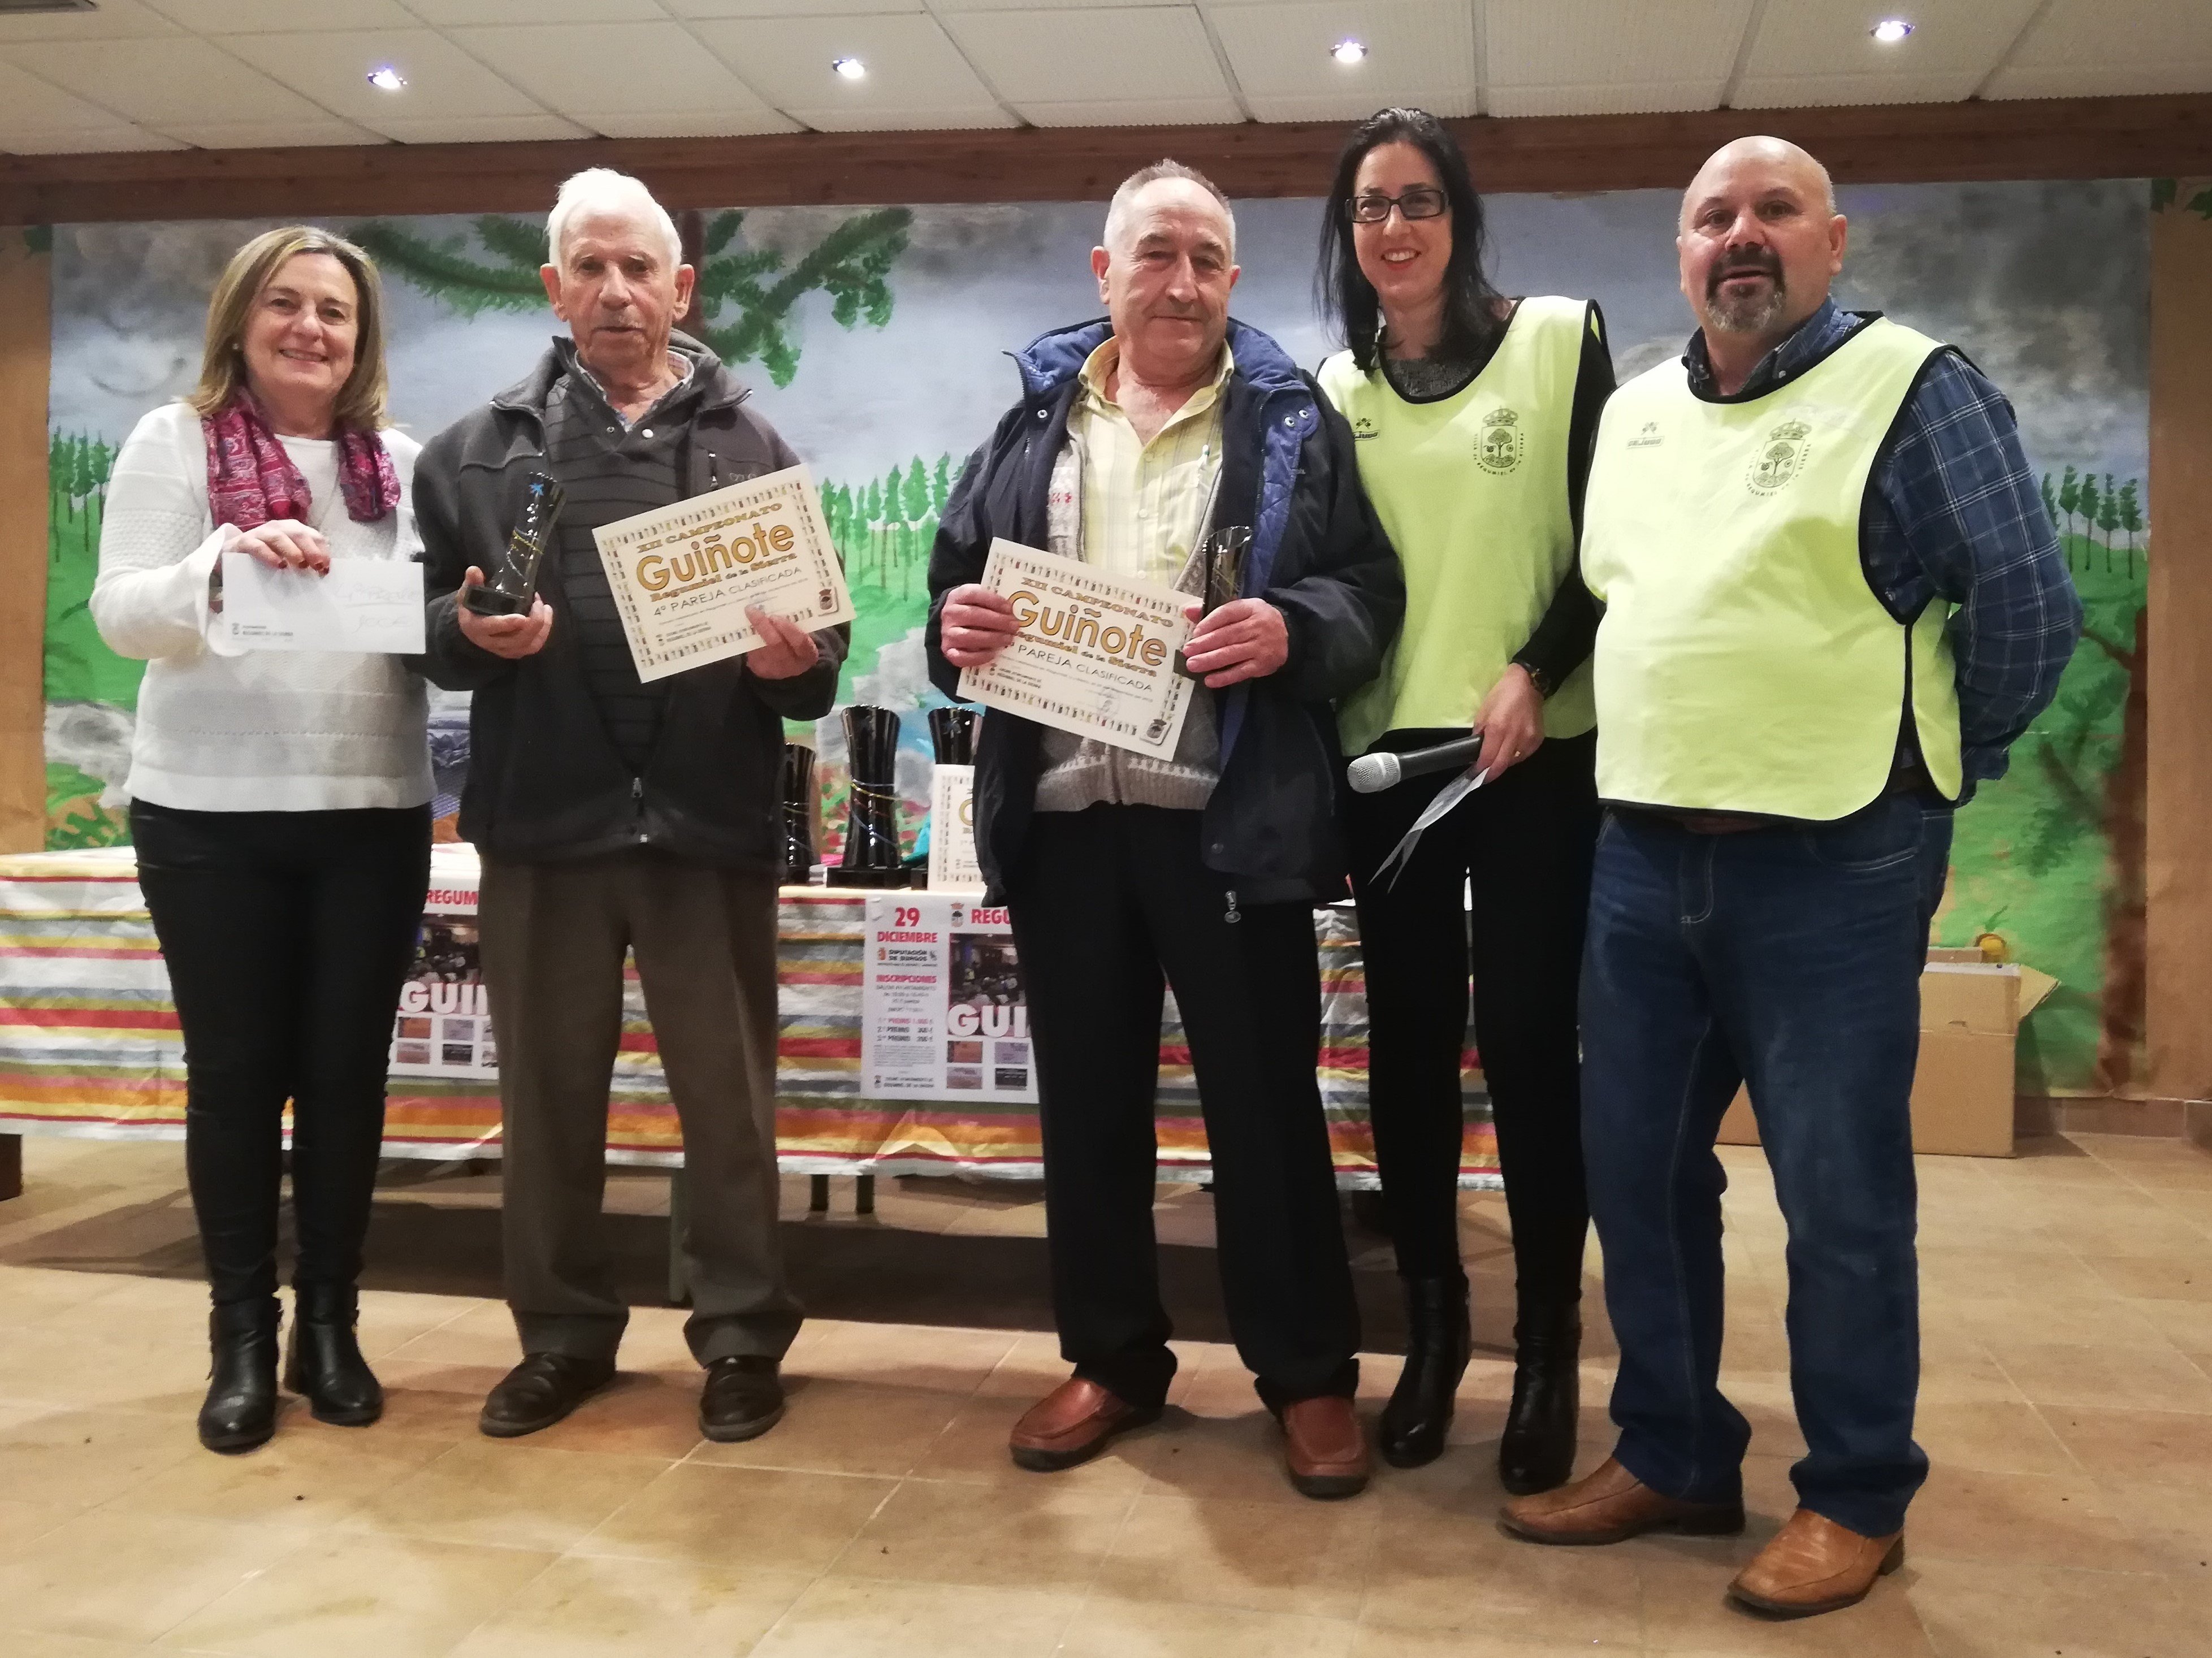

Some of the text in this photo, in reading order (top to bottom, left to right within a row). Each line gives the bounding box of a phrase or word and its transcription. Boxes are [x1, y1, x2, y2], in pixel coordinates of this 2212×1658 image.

[665, 503, 782, 545] CAMPEONATO
[637, 522, 794, 591] Guiñote
[671, 590, 726, 612] PAREJA
[728, 567, 802, 595] CLASIFICADA
[1051, 586, 1174, 627] CAMPEONATO
[1008, 590, 1167, 666] Guiñote
[1018, 645, 1072, 669] PAREJA
[1076, 664, 1153, 692] CLASIFICADA
[877, 931, 938, 943] DICIEMBRE
[895, 907, 921, 927] 29
